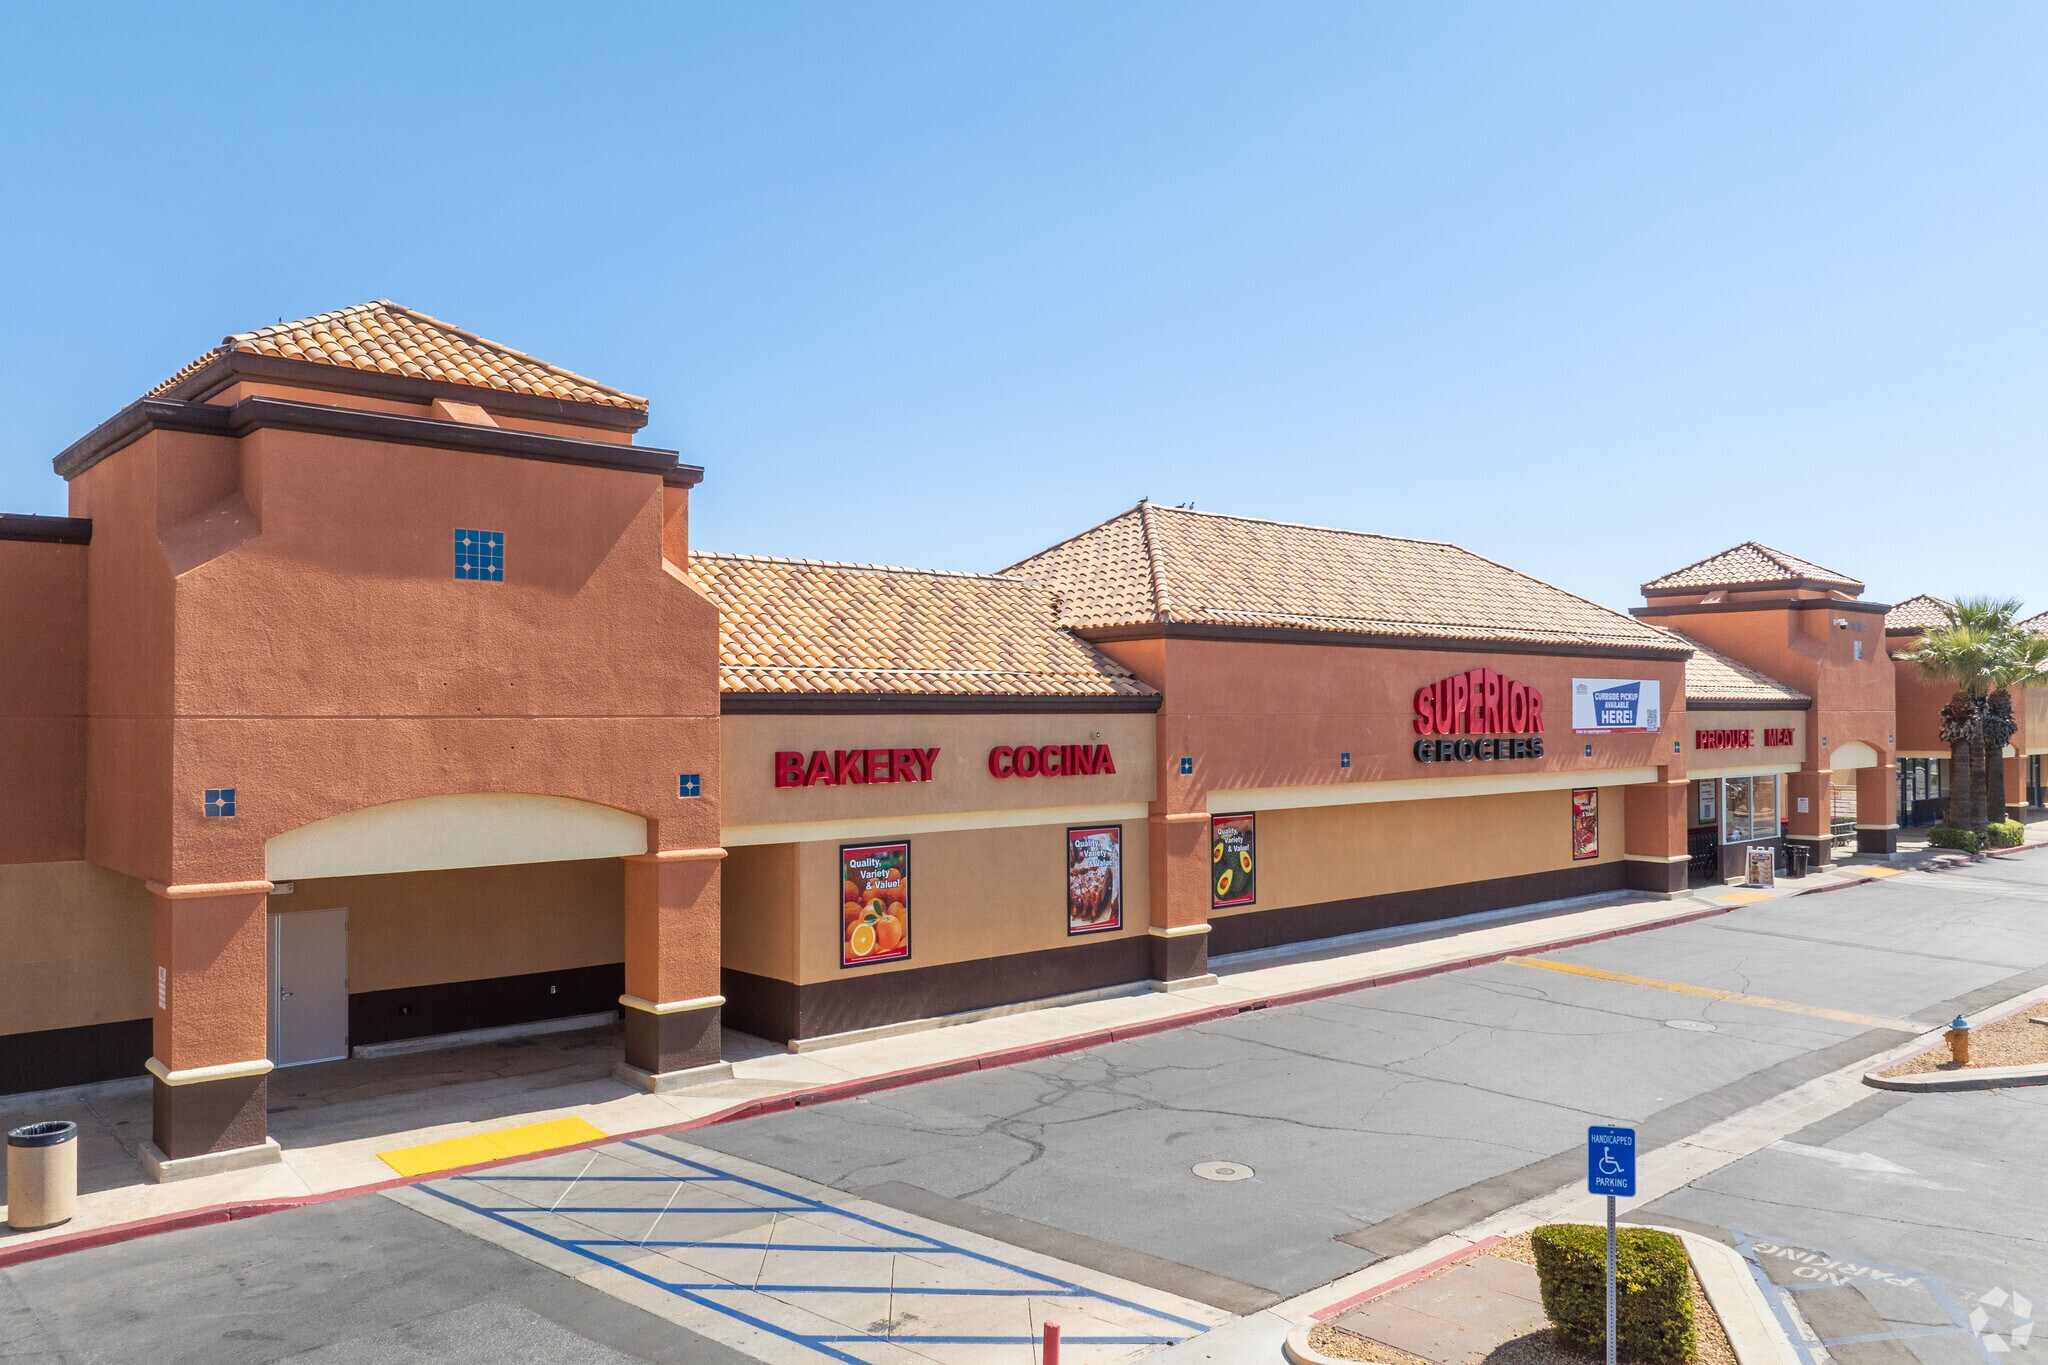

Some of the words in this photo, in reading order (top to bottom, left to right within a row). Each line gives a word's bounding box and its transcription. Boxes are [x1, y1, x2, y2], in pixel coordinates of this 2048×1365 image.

[1413, 668, 1544, 735] SUPERIOR
[1604, 701, 1630, 709] AVAILABLE
[1601, 710, 1633, 724] HERE!
[1696, 729, 1755, 750] PRODUCE
[1763, 728, 1795, 747] MEAT
[1413, 737, 1544, 763] GROCERS
[775, 747, 941, 788] BAKERY
[988, 744, 1117, 779] COCINA
[1224, 837, 1243, 845] Variety
[1083, 849, 1107, 858] Variety
[1227, 845, 1233, 853] &
[849, 858, 882, 868] Quality,
[860, 869, 889, 879] Variety
[865, 882, 872, 890] &
[875, 879, 900, 889] Value!
[1591, 1134, 1633, 1146] HANDICAPPED
[1595, 1176, 1628, 1188] PARKING
[1752, 1243, 1918, 1287] PARKING
[1792, 1266, 1853, 1287] NO
